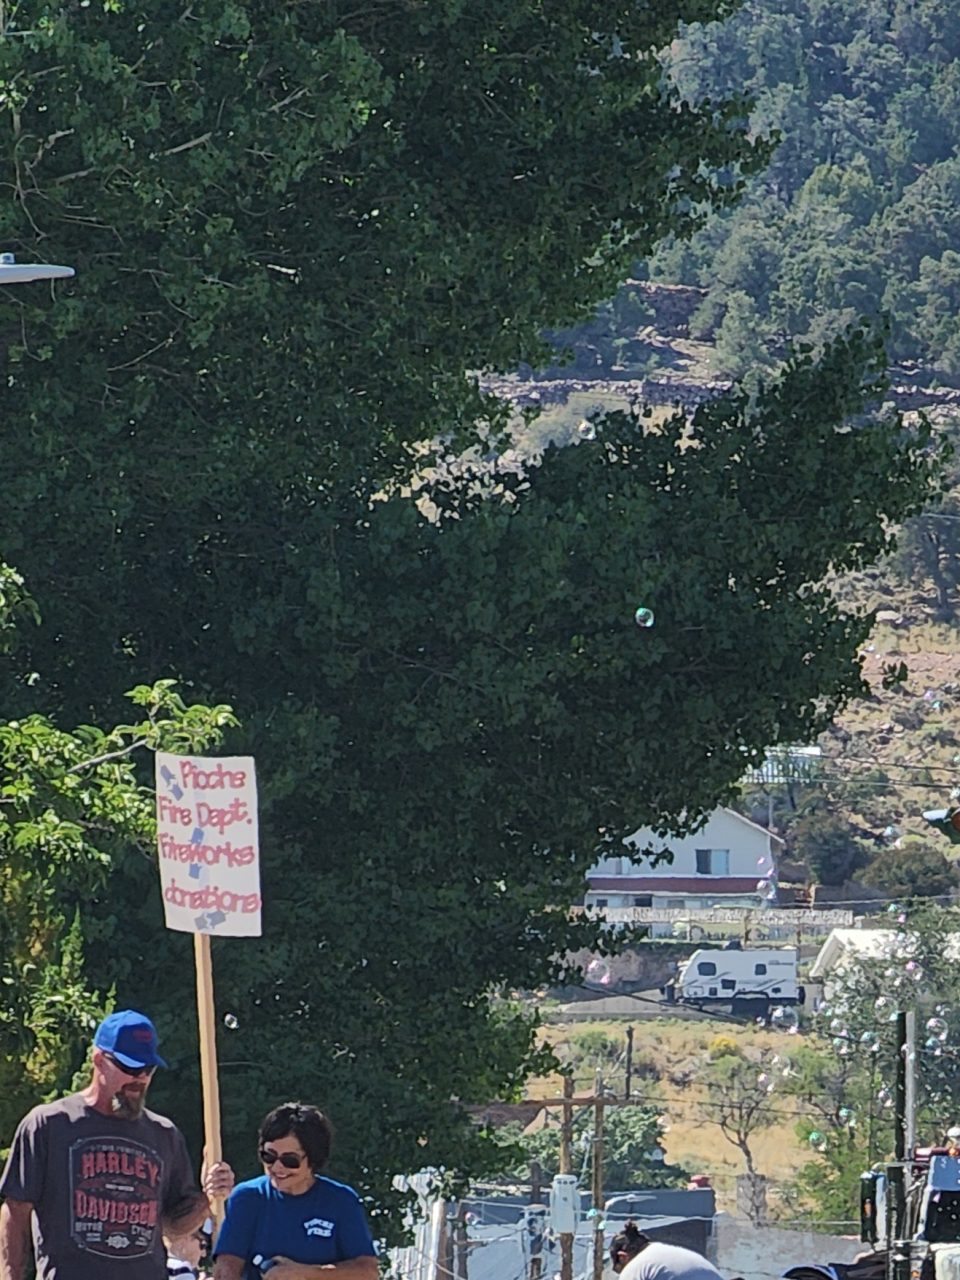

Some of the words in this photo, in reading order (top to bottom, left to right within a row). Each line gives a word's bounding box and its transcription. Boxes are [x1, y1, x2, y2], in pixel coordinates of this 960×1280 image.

[179, 760, 247, 789] Pioche
[158, 796, 192, 826] Fire
[196, 797, 253, 835] Dept.
[158, 832, 256, 868] Fireworks
[164, 878, 263, 913] donations
[82, 1151, 159, 1187] HARLEY
